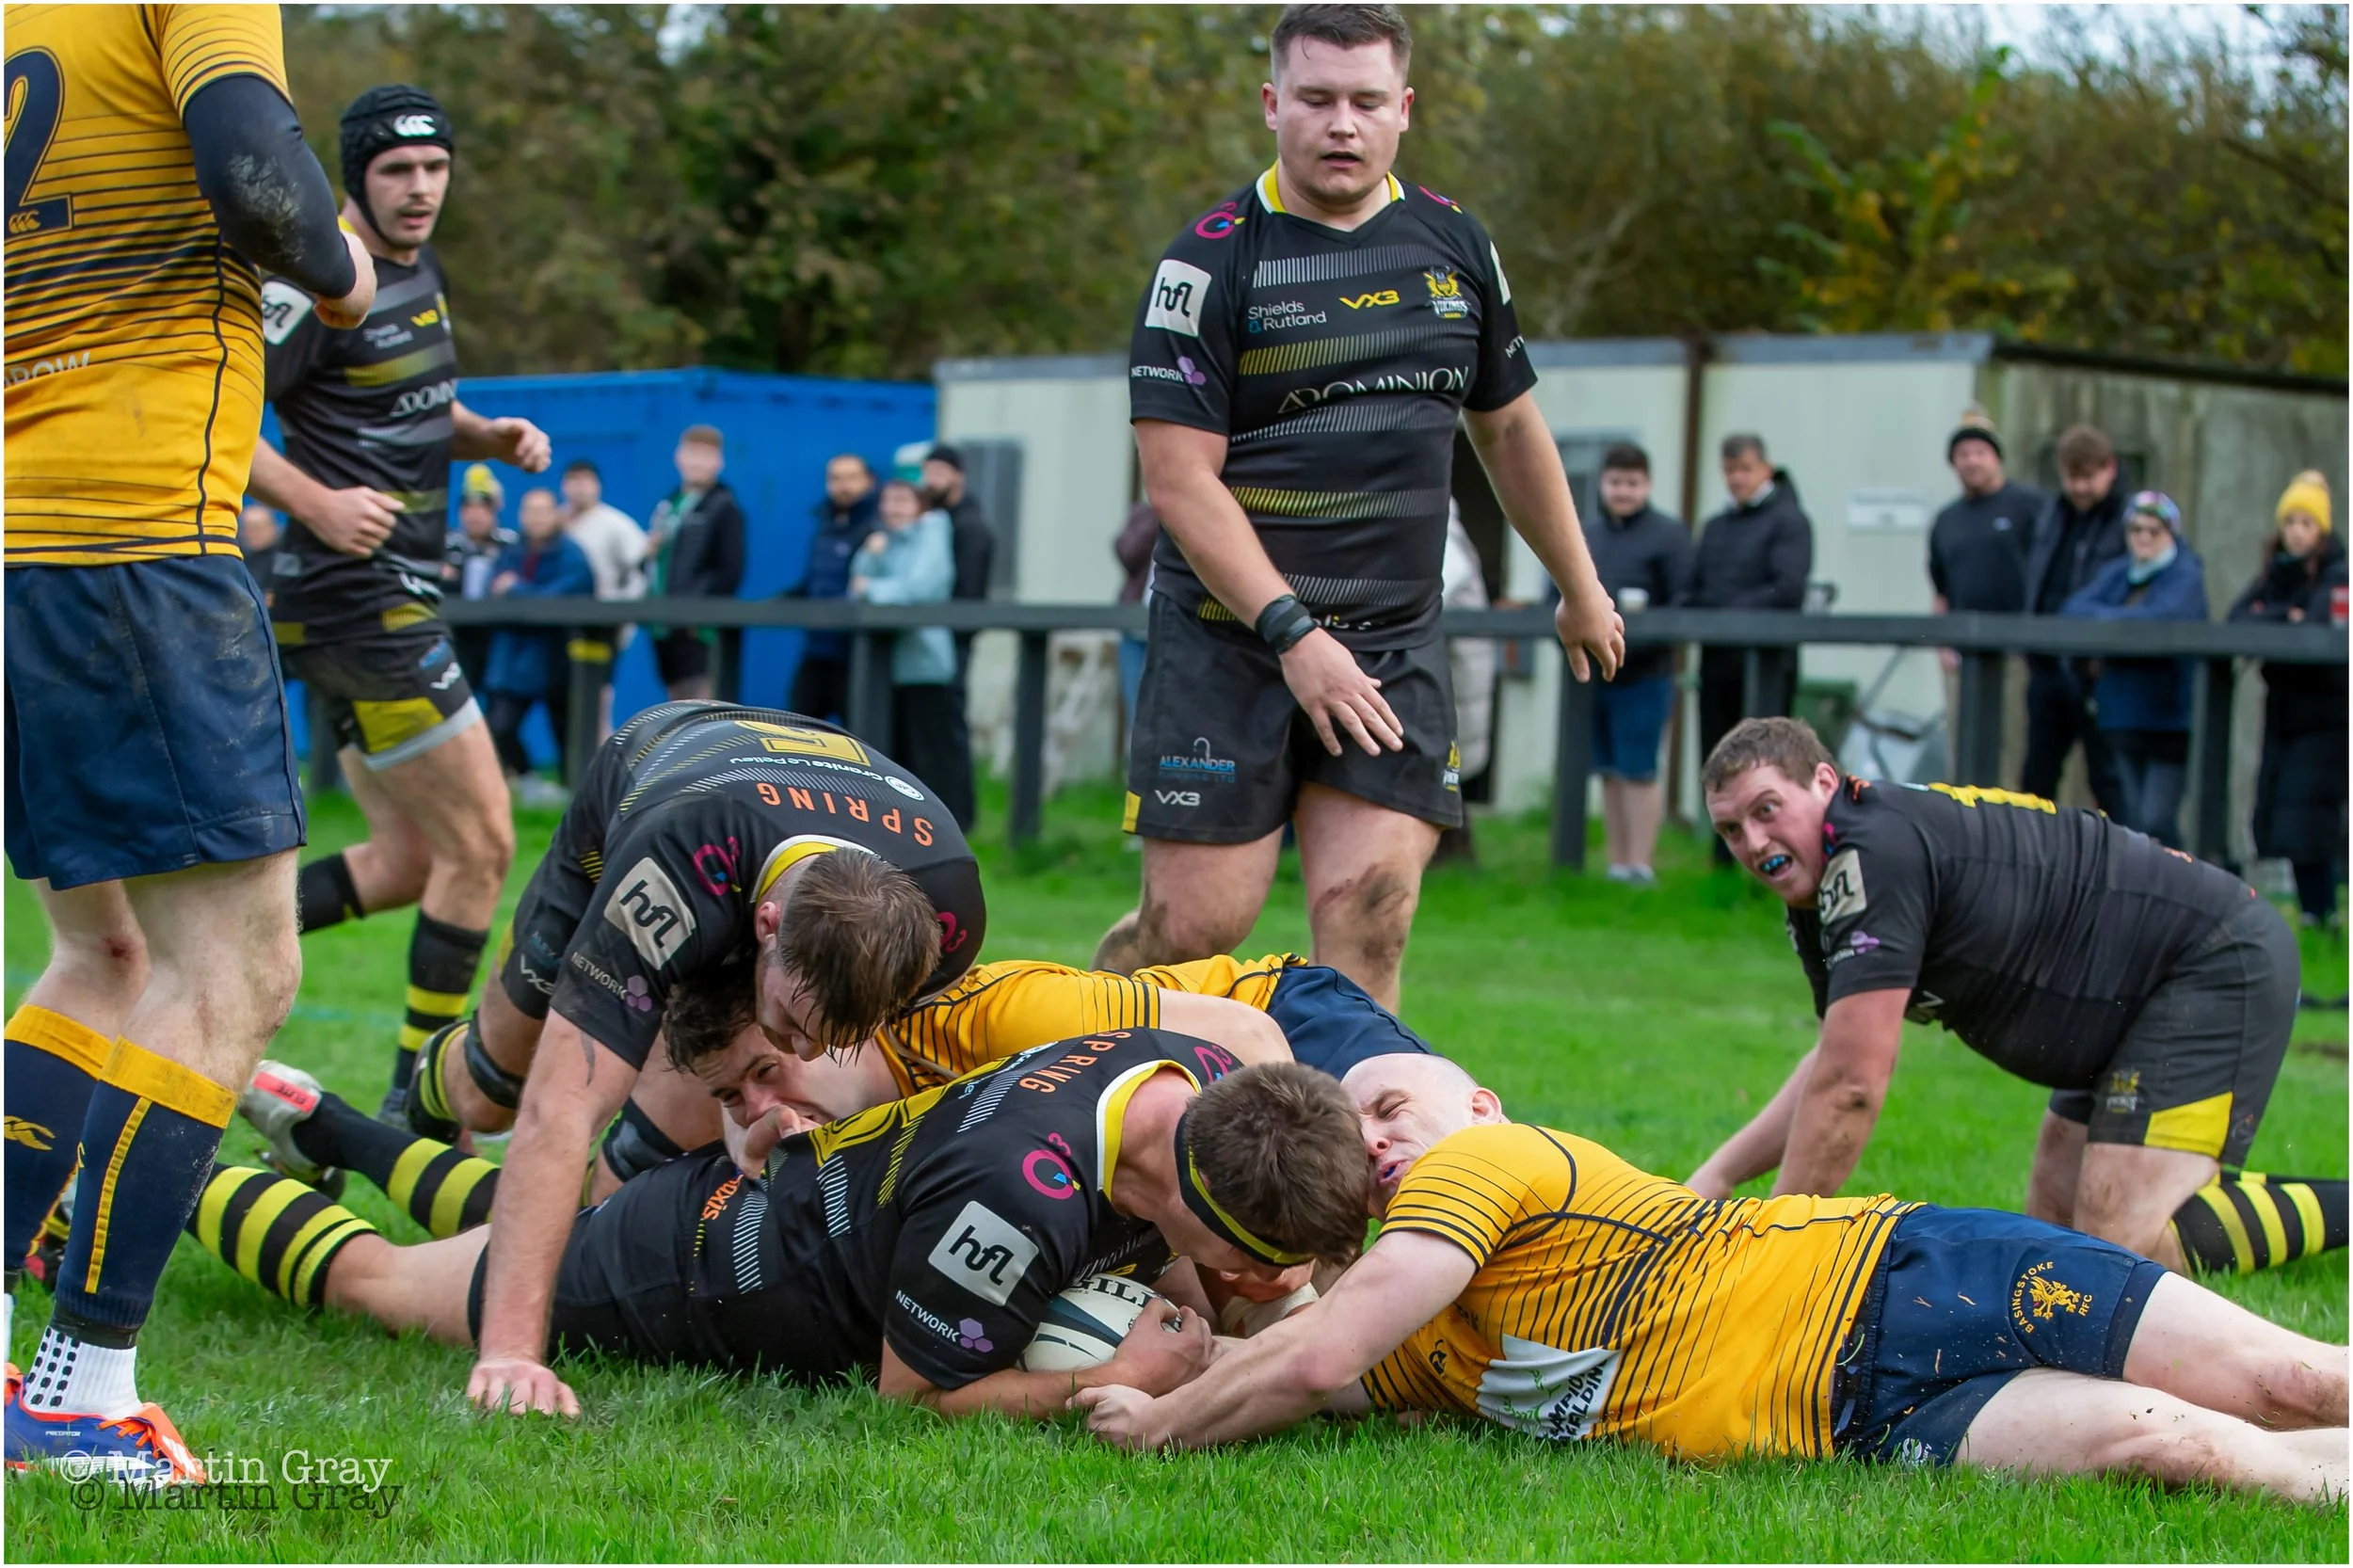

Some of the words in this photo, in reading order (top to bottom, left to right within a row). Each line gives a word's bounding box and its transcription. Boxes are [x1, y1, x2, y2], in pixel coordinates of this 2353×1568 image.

[1156, 277, 1193, 318] hfl
[1248, 300, 1306, 320] Shields
[1338, 289, 1401, 310] VX3
[1262, 310, 1328, 331] Rutland
[1131, 365, 1185, 383] NETWORK
[1159, 755, 1236, 774] ALEXANDER
[756, 782, 935, 847] SPRING
[1155, 790, 1201, 808] VX3
[619, 879, 680, 950] hfl
[569, 952, 629, 1000] NETWORK
[1018, 1032, 1131, 1094] SPRING
[948, 1224, 1015, 1287] hfl
[895, 1289, 961, 1343] NETWORK
[2011, 1261, 2055, 1334] BASINGSTOKE
[2077, 1293, 2093, 1317] RFC
